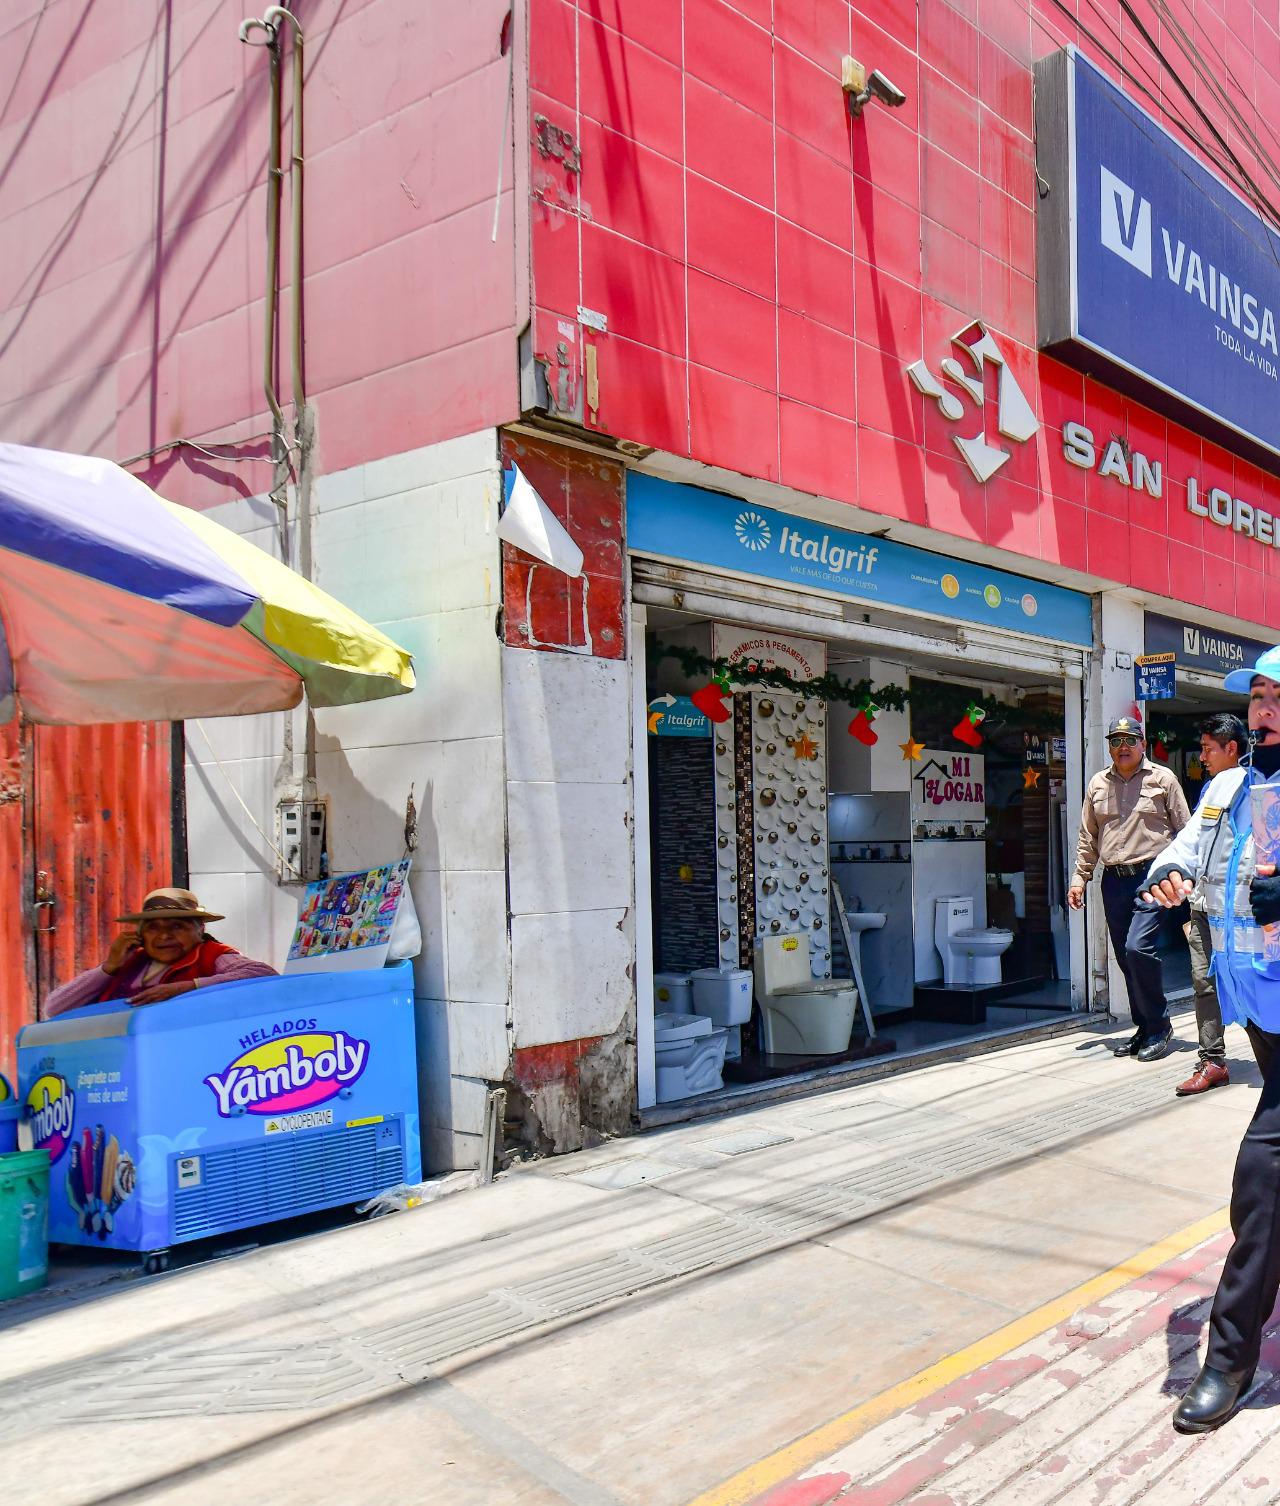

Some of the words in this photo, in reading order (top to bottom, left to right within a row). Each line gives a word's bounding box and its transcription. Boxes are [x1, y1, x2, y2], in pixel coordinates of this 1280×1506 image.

[1161, 227, 1279, 356] VAINSA
[1215, 325, 1242, 356] TODA
[1244, 345, 1256, 366] LA
[1257, 353, 1278, 381] VIDA
[1063, 421, 1163, 498] SAN
[778, 527, 880, 575] Italgrif
[772, 640, 813, 678] PEGAMENTOS
[1202, 635, 1244, 662] VAINSA
[1149, 666, 1167, 674] VAINSA
[667, 714, 706, 728] Italgrif
[951, 757, 971, 777] MI
[926, 779, 985, 805] HOGAR
[238, 1018, 318, 1049] HELADOS
[207, 1033, 366, 1114] Yámboly
[281, 1111, 333, 1132] CYCLOPENTANE
